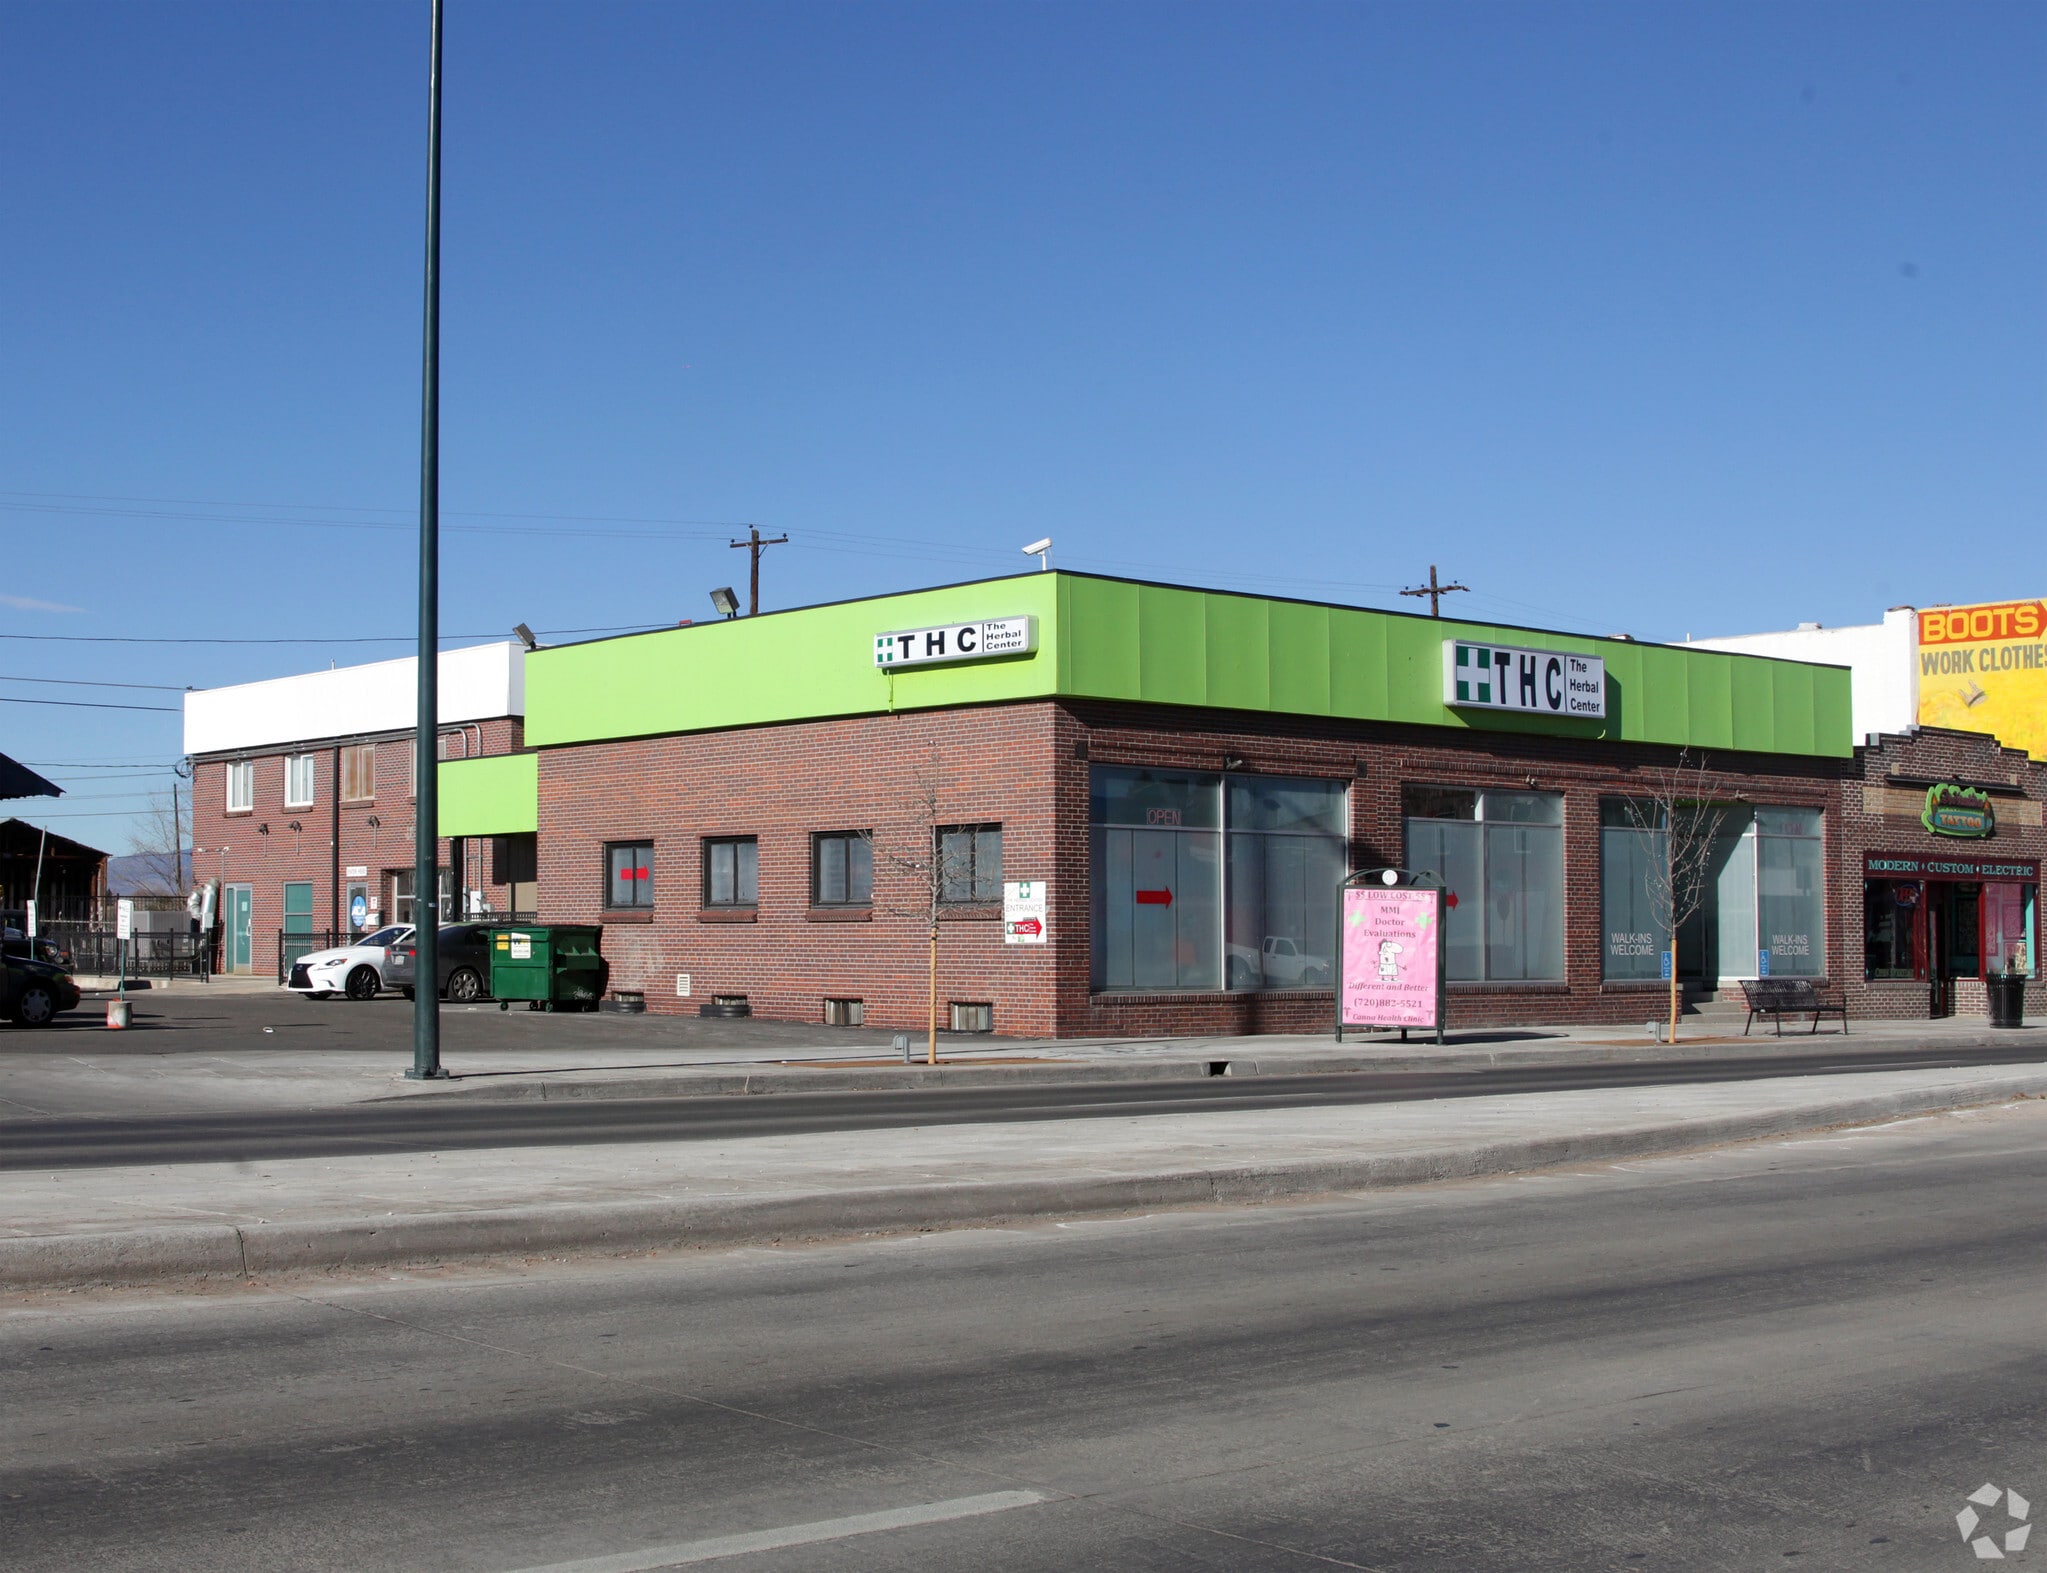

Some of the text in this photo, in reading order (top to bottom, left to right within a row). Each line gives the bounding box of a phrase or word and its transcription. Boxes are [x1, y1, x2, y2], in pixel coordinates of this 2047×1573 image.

[986, 623, 1006, 631] The
[1923, 605, 2039, 642] BOOTS
[986, 630, 1021, 641] Herbal
[897, 627, 976, 659] THC
[986, 640, 1022, 650] Center
[1920, 643, 2047, 676] WORK CLOTHE
[1570, 658, 1587, 673] The
[1494, 651, 1562, 711] THC
[1569, 679, 1599, 693] Herbal
[1570, 698, 1600, 713] Center
[1148, 809, 1181, 826] OPEN
[1940, 814, 1982, 828] TATTOO
[1868, 859, 2034, 877] MODERN CUSTOM ELECTRIC
[1368, 891, 1387, 899] LOW
[1005, 904, 1043, 912] ENTRANCE
[1375, 918, 1405, 926] Doctor
[1015, 924, 1030, 933] THC
[1363, 929, 1416, 938] Evaluations
[1611, 932, 1653, 944] WALK-INS
[1772, 934, 1808, 945] WALK-INS
[1610, 944, 1654, 956] WELCOME
[1771, 945, 1810, 956] WELCOME
[1348, 982, 1385, 991] Different
[1403, 984, 1429, 992] Better
[1377, 1014, 1402, 1022] Health
[1403, 1015, 1424, 1023] Clinic
